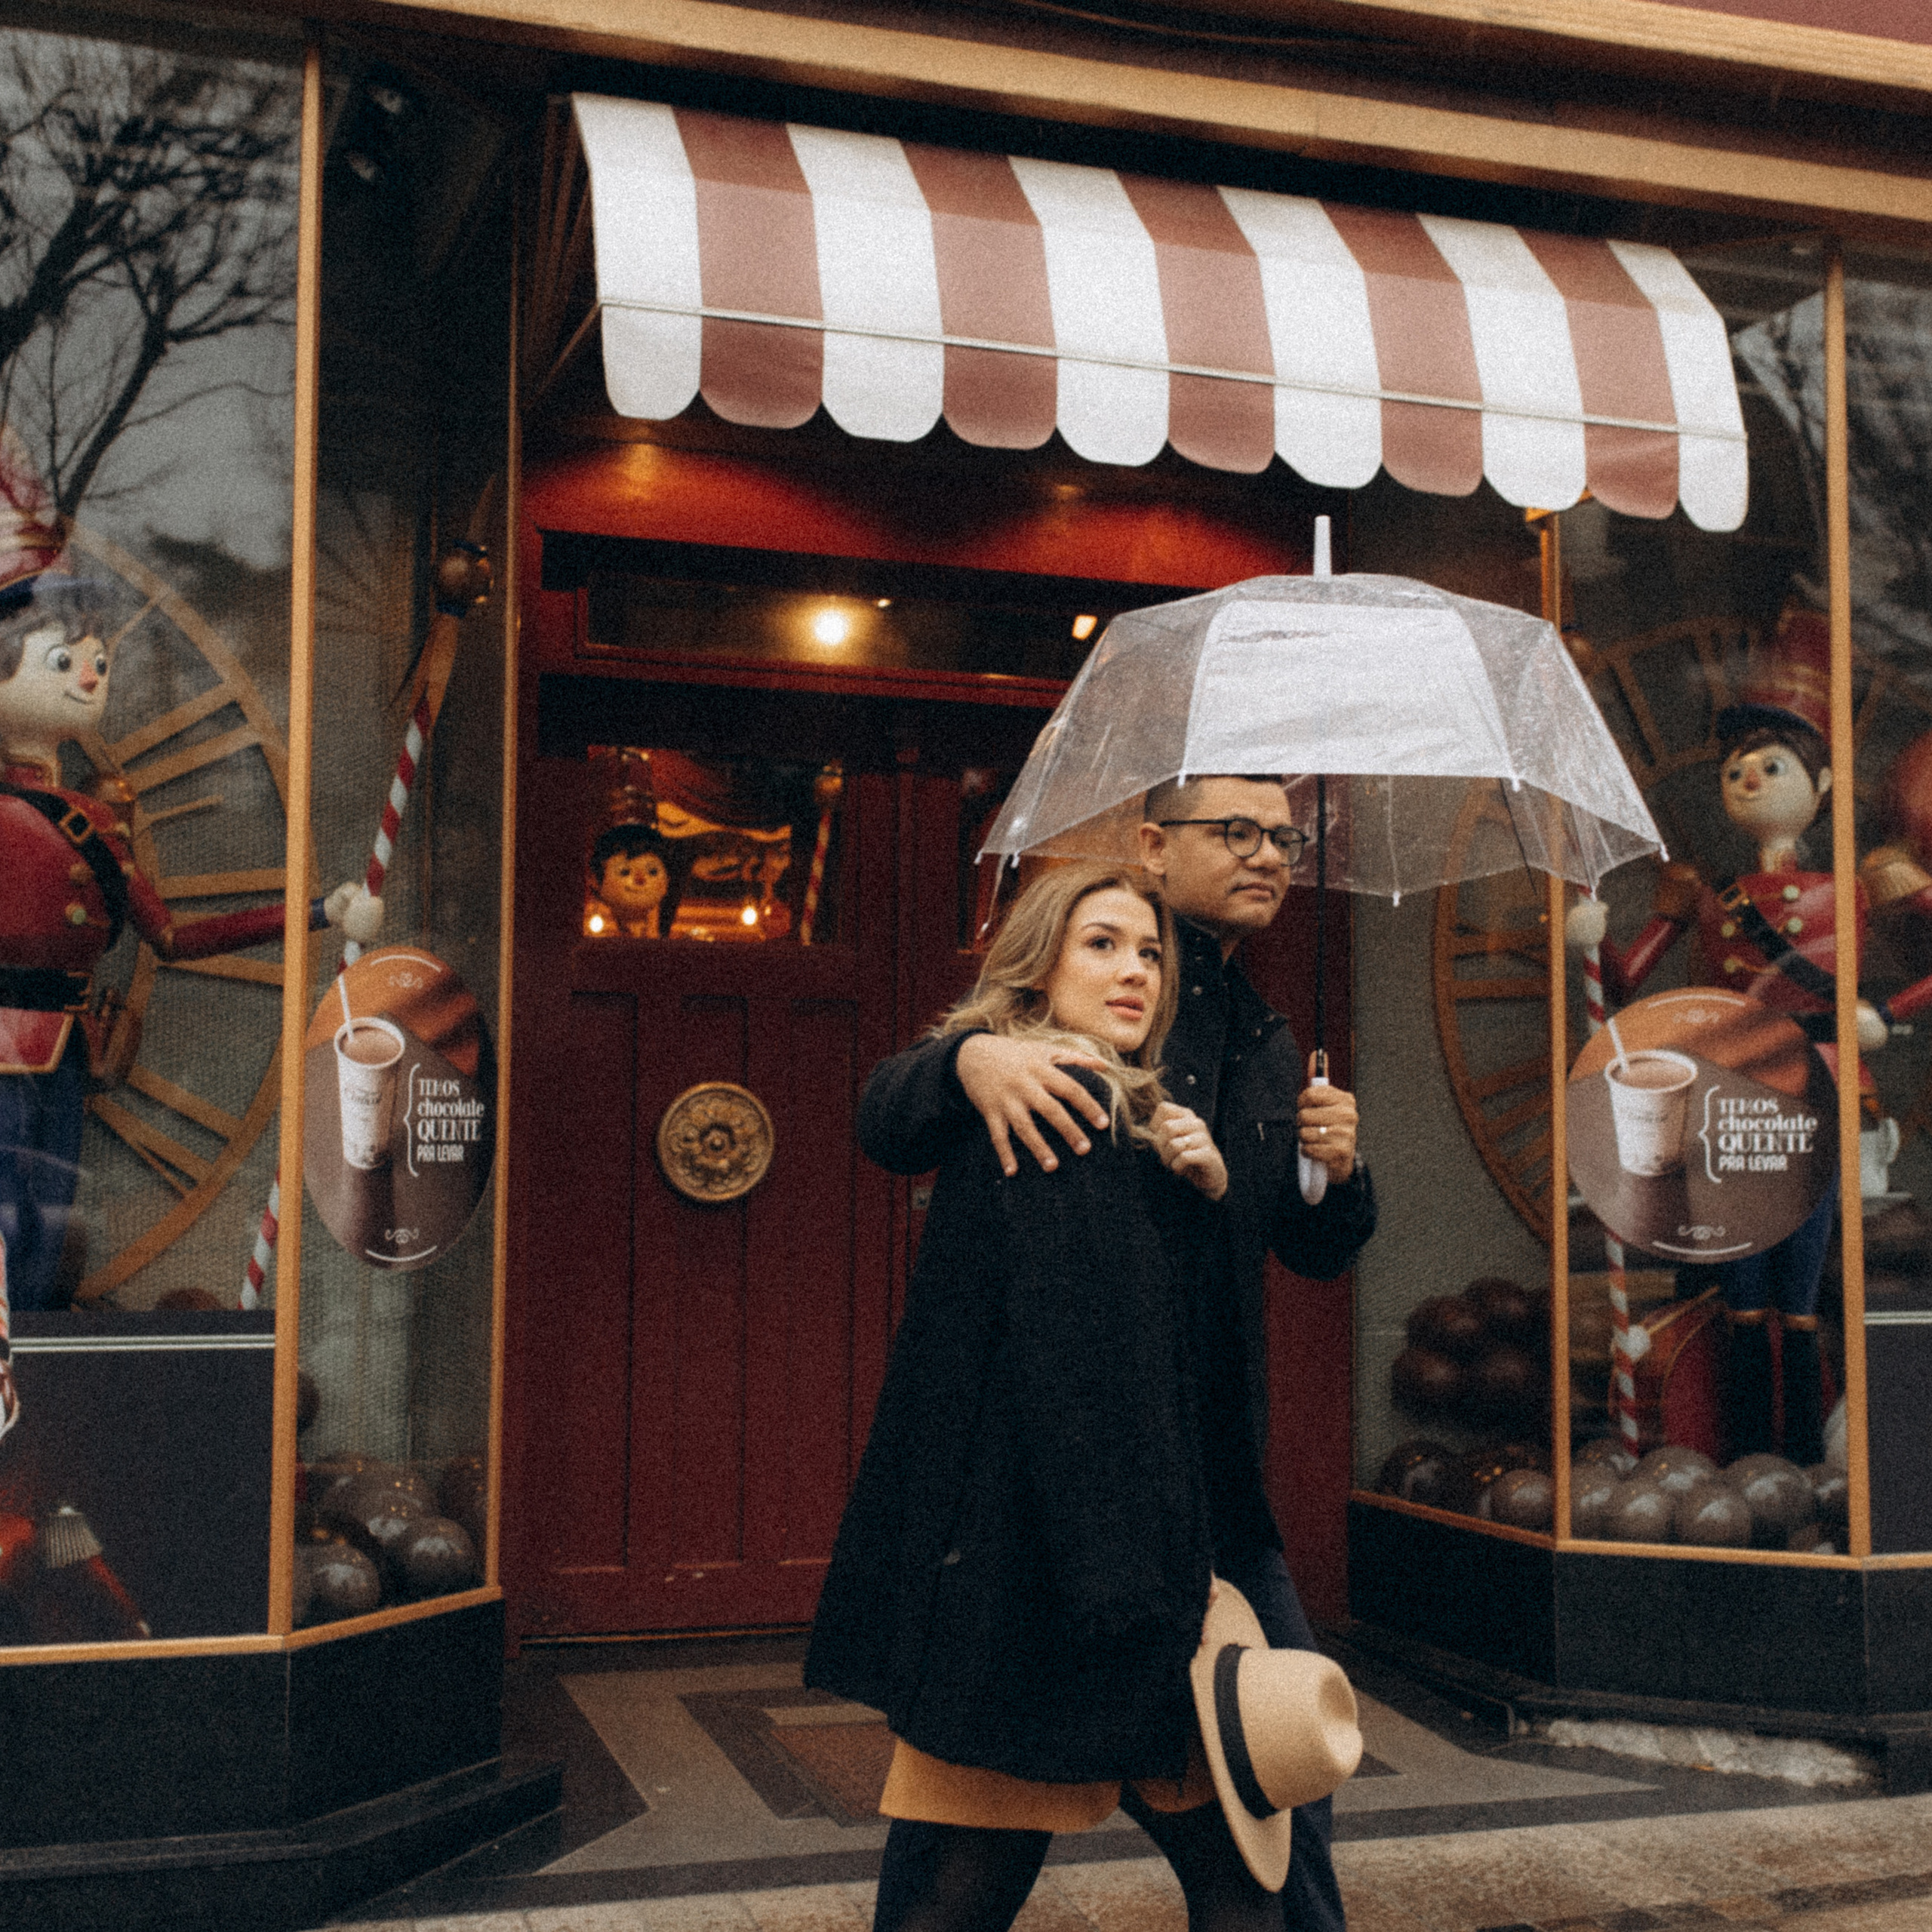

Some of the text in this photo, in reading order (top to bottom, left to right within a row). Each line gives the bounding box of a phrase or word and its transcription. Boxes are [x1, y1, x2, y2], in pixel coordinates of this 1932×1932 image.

[417, 1097, 485, 1117] chocolate
[417, 1118, 481, 1142] QUENTE
[1718, 1114, 1818, 1132] chocolate
[1718, 1131, 1814, 1154] QUENTE
[417, 1143, 464, 1162] PRA LEVAR
[1718, 1154, 1788, 1171] PRA LEVAR
